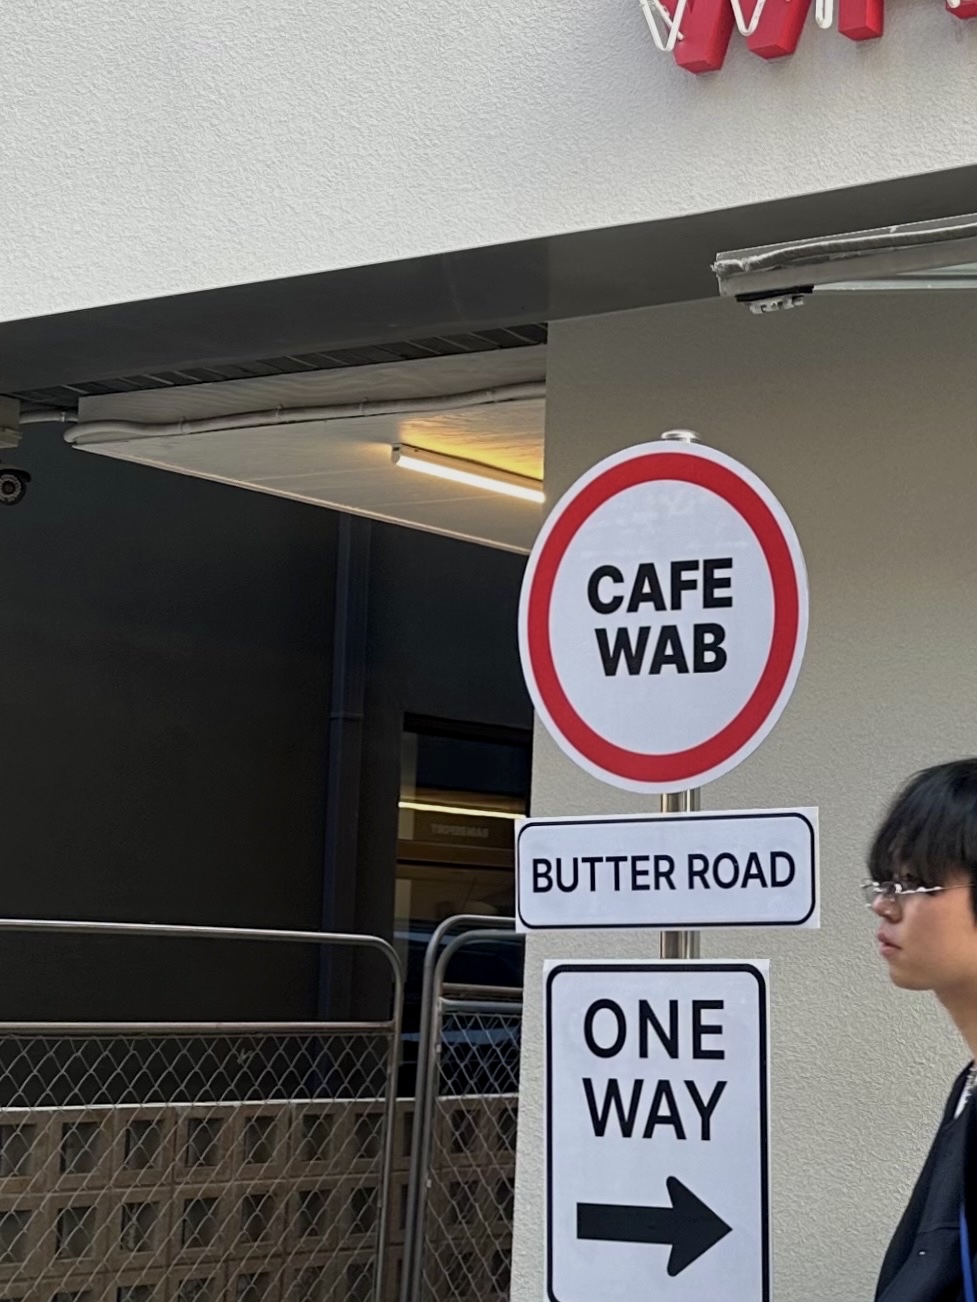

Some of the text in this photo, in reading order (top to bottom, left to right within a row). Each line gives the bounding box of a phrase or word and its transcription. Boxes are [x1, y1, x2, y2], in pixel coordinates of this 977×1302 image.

[587, 557, 733, 615] CAFE
[594, 622, 728, 677] WAB
[532, 850, 796, 893] BUTTER ROAD
[583, 998, 726, 1060] ONE
[581, 1077, 728, 1141] WAY
